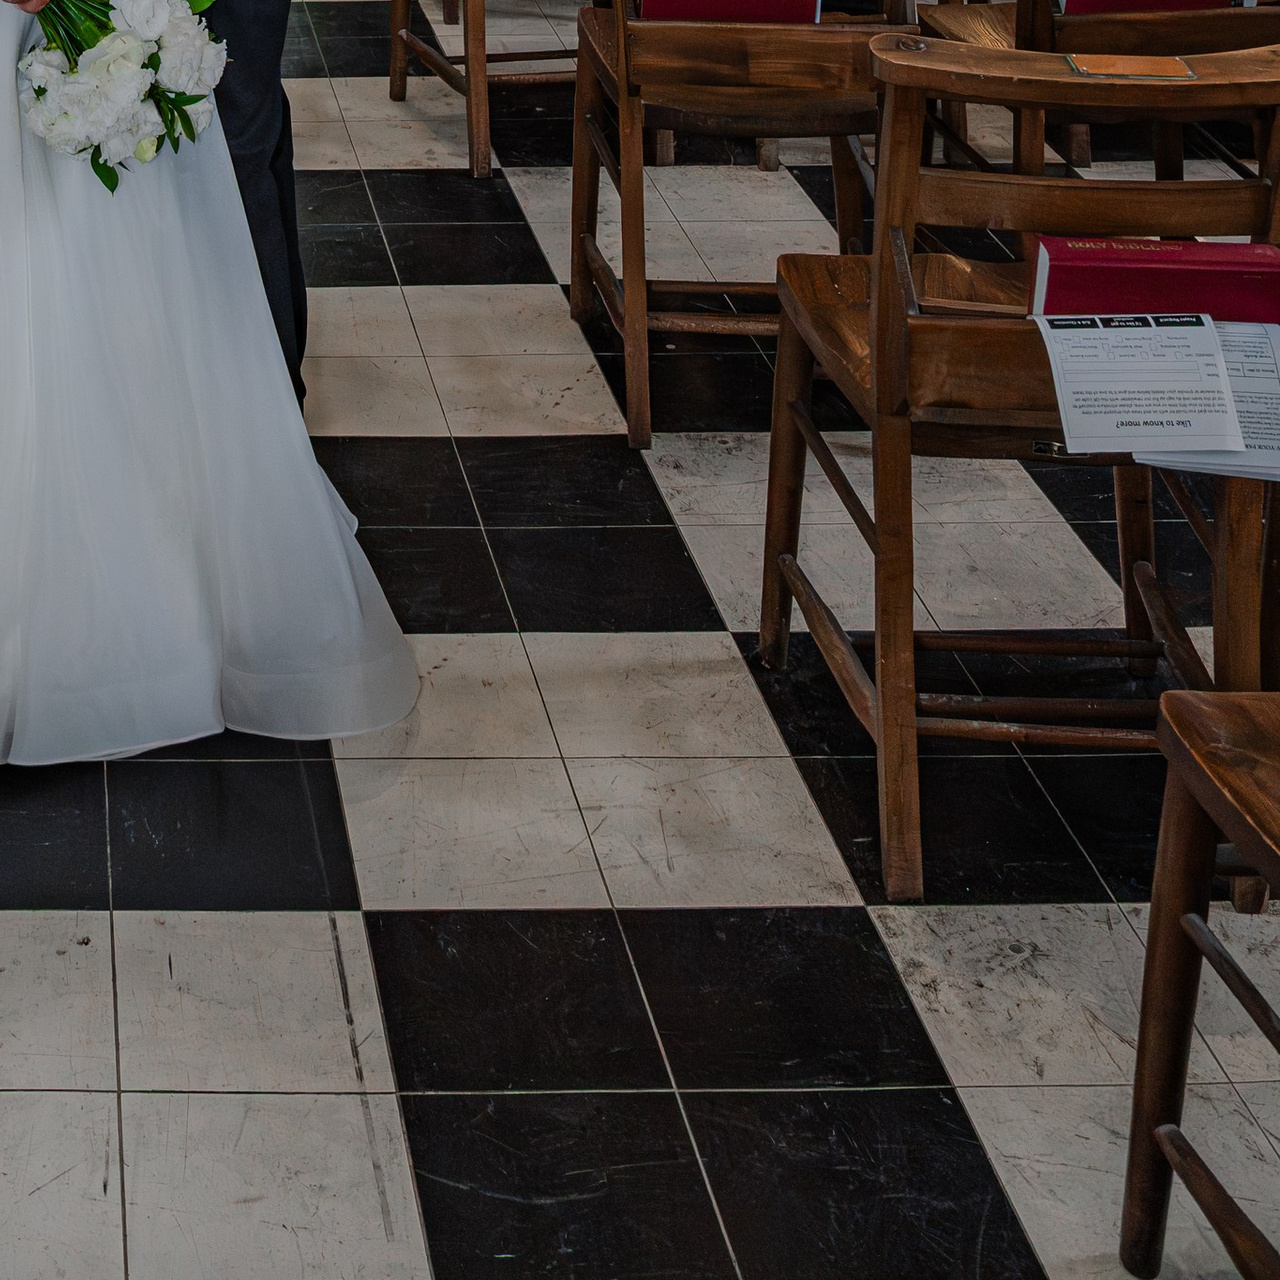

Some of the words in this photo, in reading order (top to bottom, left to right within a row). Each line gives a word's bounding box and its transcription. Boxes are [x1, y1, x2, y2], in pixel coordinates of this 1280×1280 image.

[1066, 240, 1107, 250] HOLY
[1115, 420, 1141, 429] more?
[1142, 420, 1165, 429] know
[1165, 419, 1175, 428] to
[1175, 419, 1192, 428] Like
